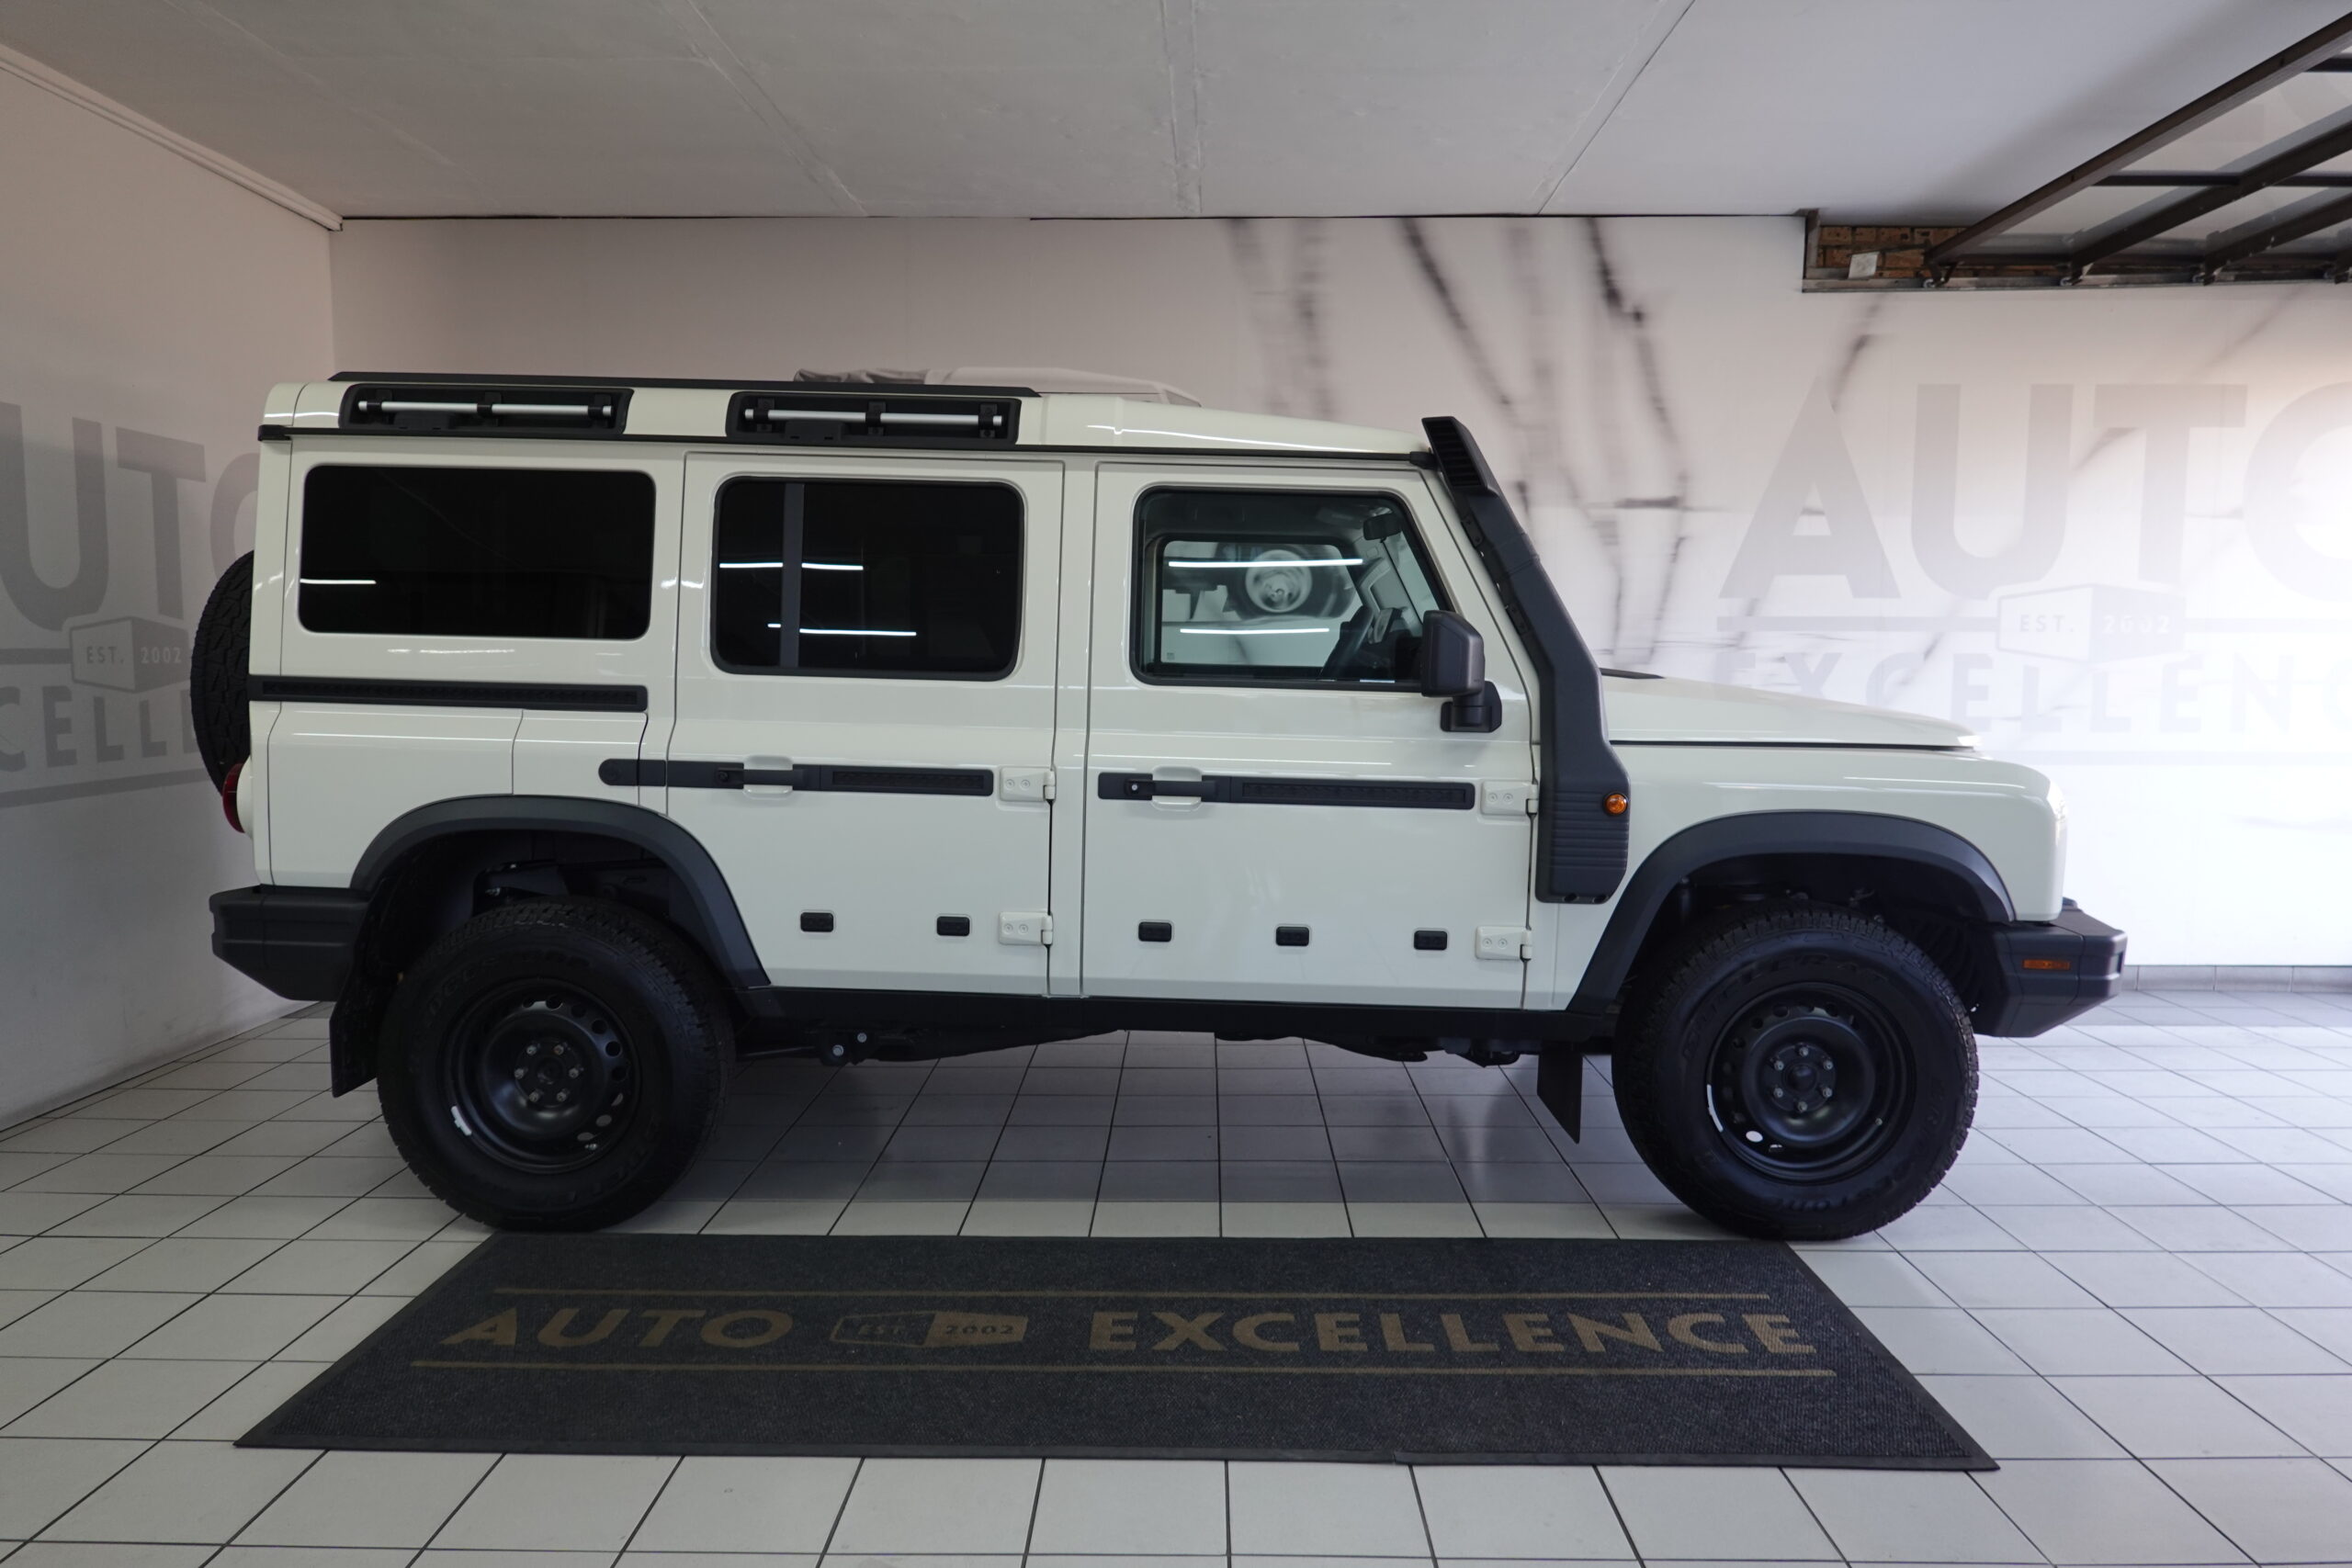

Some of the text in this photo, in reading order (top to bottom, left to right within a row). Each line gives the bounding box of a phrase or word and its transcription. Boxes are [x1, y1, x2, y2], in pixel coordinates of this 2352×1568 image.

[2018, 615, 2171, 634] EST. 2002
[86, 646, 182, 664] EST. 2002
[439, 1308, 793, 1348] AUTO
[945, 1325, 1014, 1336] 2002
[1088, 1311, 1816, 1354] EXCELLENCE
